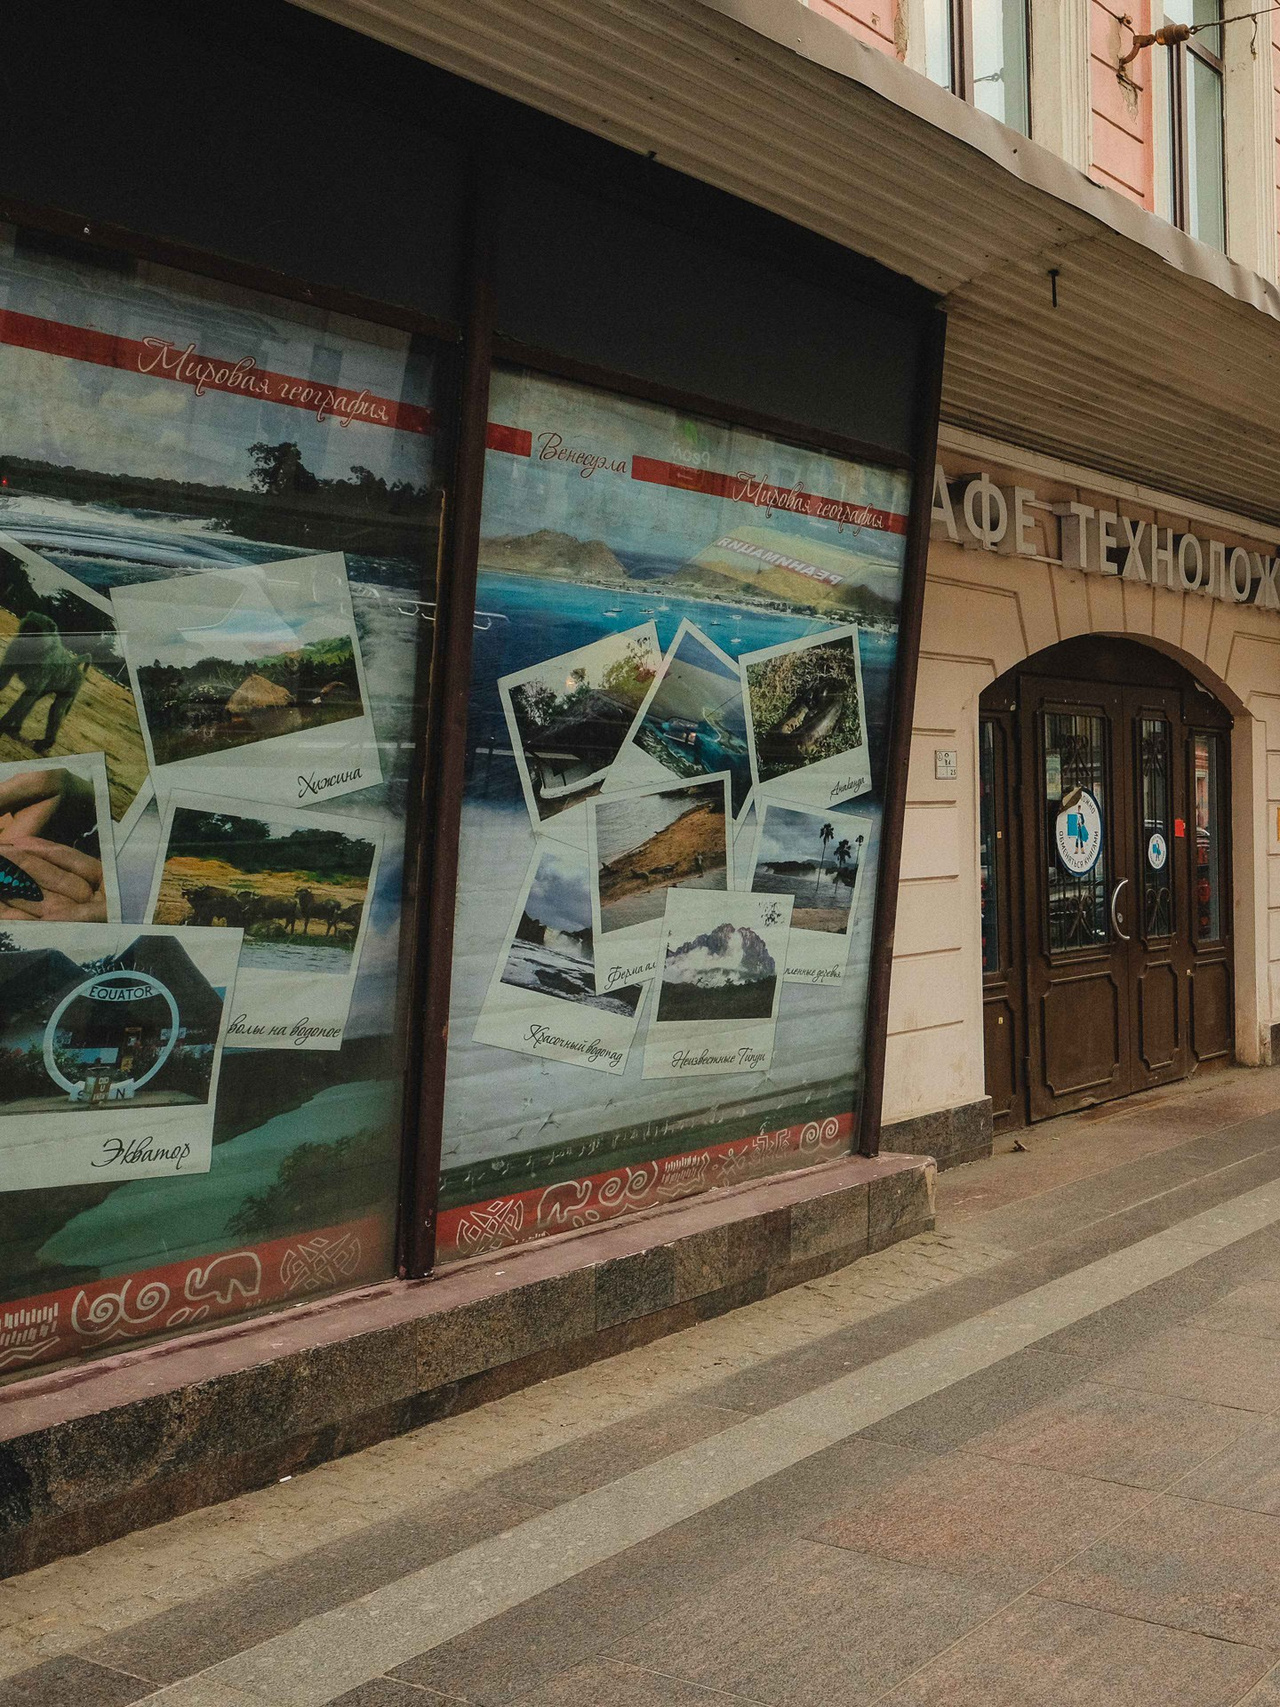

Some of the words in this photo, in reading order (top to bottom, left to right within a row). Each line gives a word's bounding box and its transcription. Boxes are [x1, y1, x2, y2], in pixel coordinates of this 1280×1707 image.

[138, 336, 272, 397] Мировая
[280, 383, 389, 427] география
[537, 431, 628, 478] Венесуэла
[732, 470, 812, 519] Мировая
[816, 497, 886, 537] география
[298, 766, 363, 798] Хижина
[1084, 830, 1099, 866] КНИГАМИ
[88, 984, 153, 1001] EQUATOR
[604, 965, 643, 990] Ферма
[267, 1024, 287, 1037] на
[289, 1016, 342, 1045] водопое
[523, 1023, 586, 1053] Красочный
[585, 1038, 623, 1068] водопад
[671, 1048, 736, 1069] Неизвестные
[116, 1087, 126, 1100] N
[91, 1136, 191, 1170] Экватор
